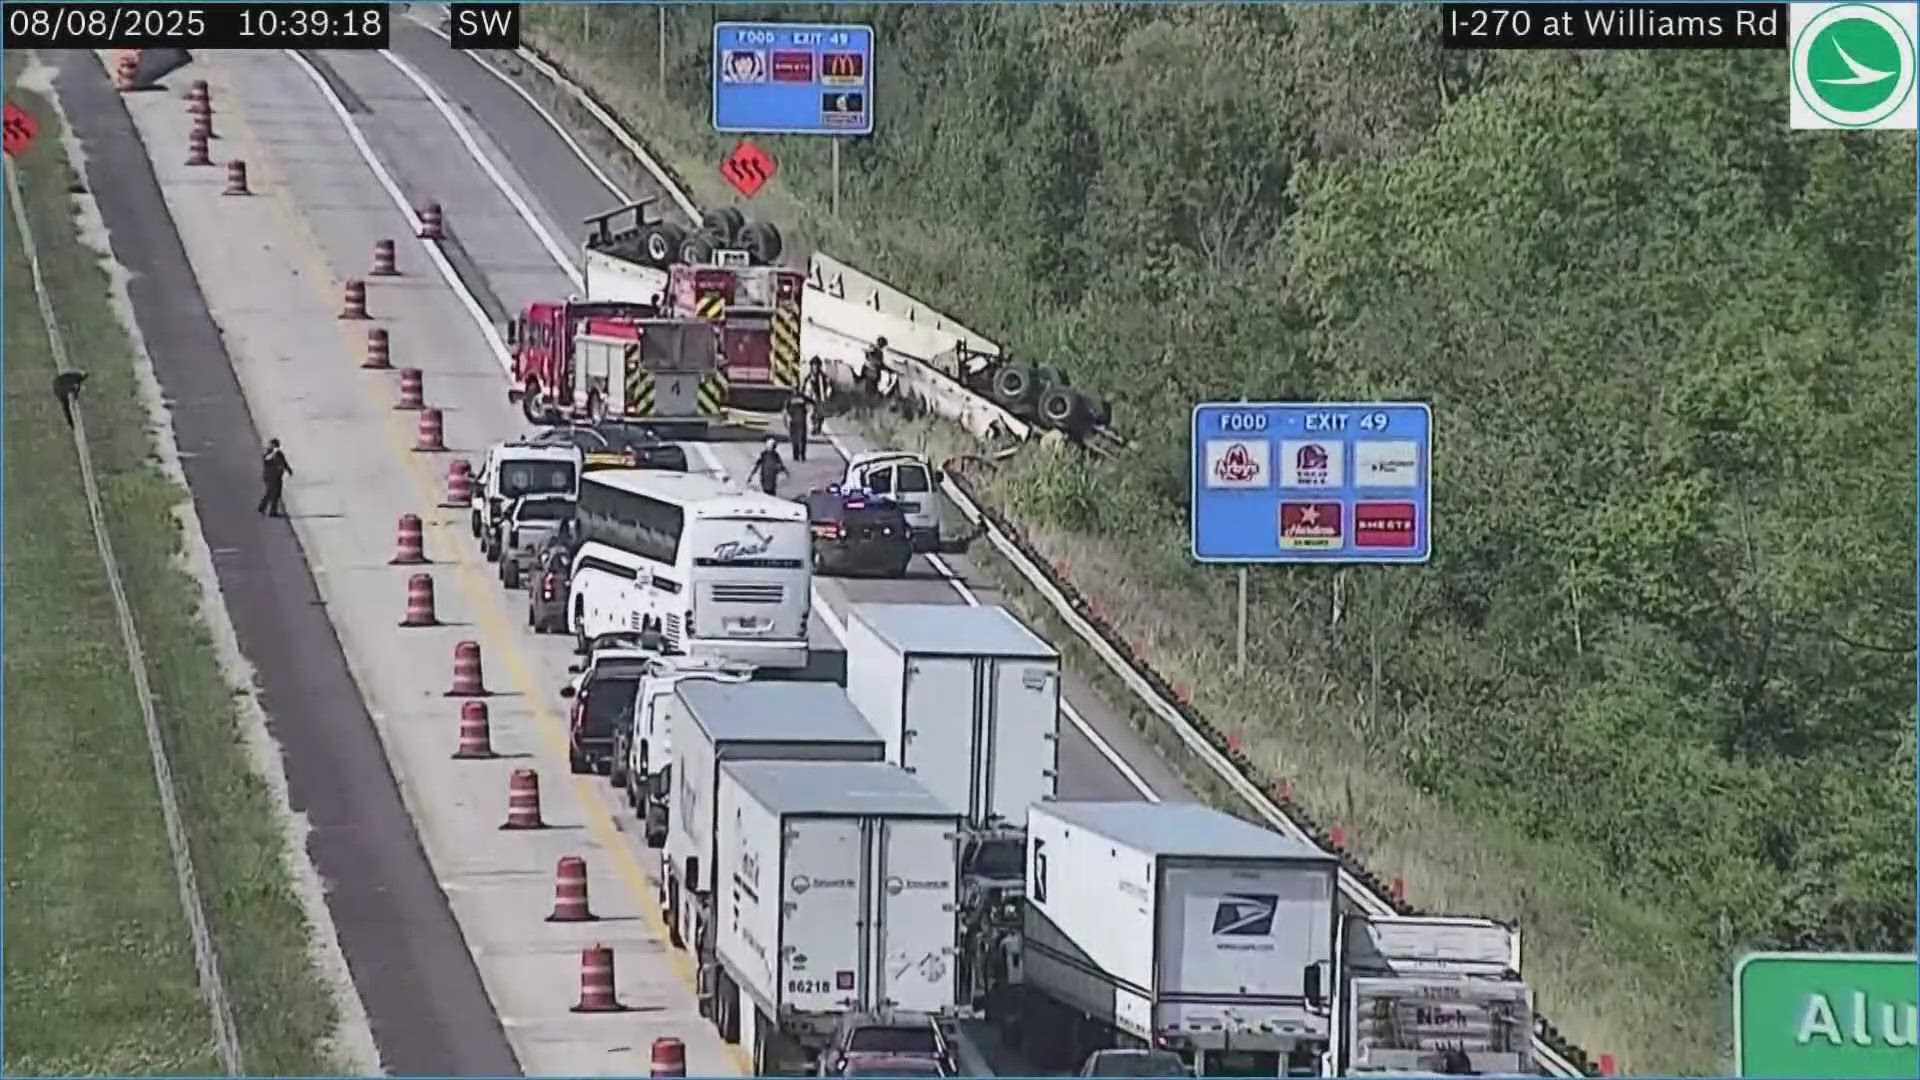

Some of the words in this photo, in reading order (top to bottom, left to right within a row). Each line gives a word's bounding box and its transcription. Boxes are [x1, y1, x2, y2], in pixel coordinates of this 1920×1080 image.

[737, 30, 775, 43] FOOD
[792, 31, 822, 44] EXIT
[1220, 413, 1267, 430] FOOD
[1305, 413, 1348, 430] EXIT
[1360, 413, 1388, 430] 49
[1797, 991, 1917, 1046] Alu
